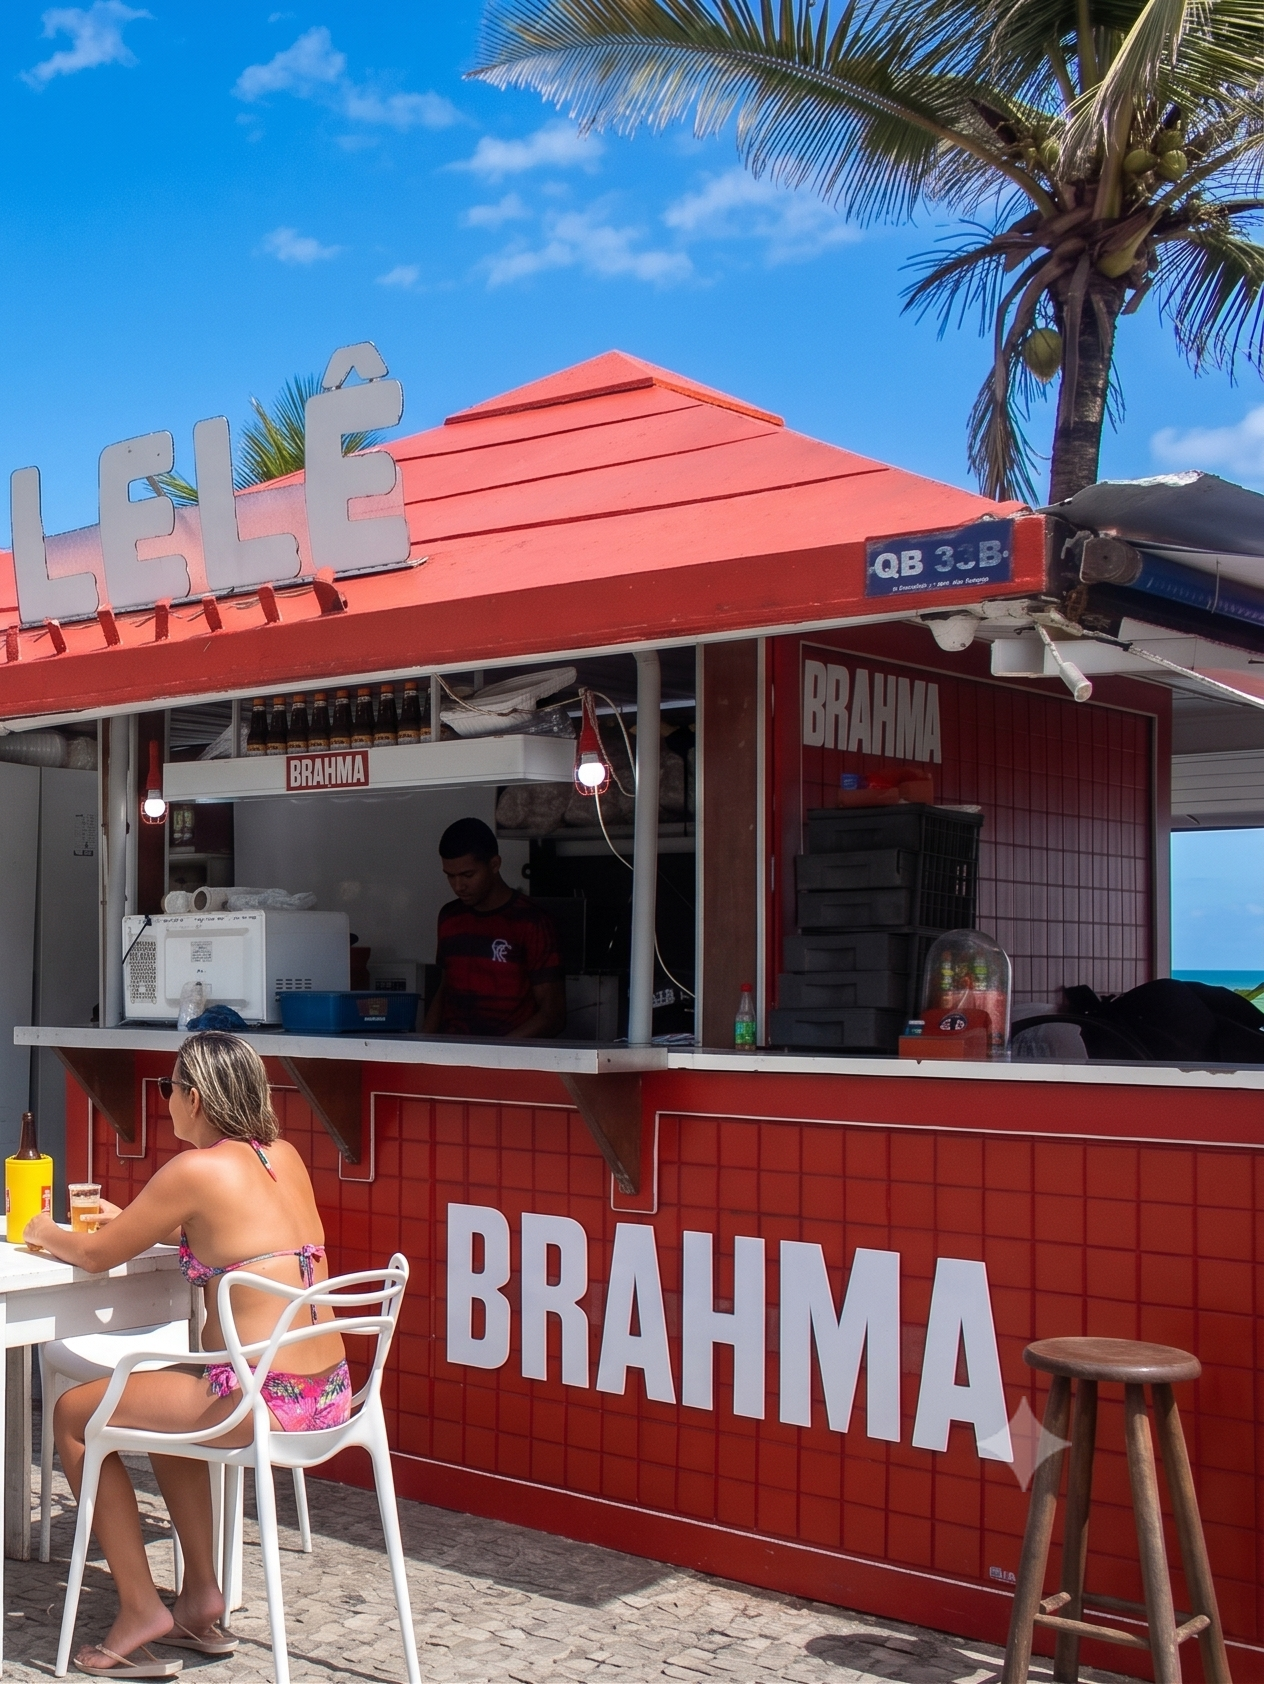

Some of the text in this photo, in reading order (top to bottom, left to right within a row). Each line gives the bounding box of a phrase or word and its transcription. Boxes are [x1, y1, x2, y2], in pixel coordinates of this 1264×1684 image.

[10, 340, 411, 625] LELÊ
[874, 550, 924, 579] QB
[803, 659, 942, 764] BRAHMA
[289, 754, 365, 788] BRAHMA
[446, 1202, 1015, 1464] BRAHMA
